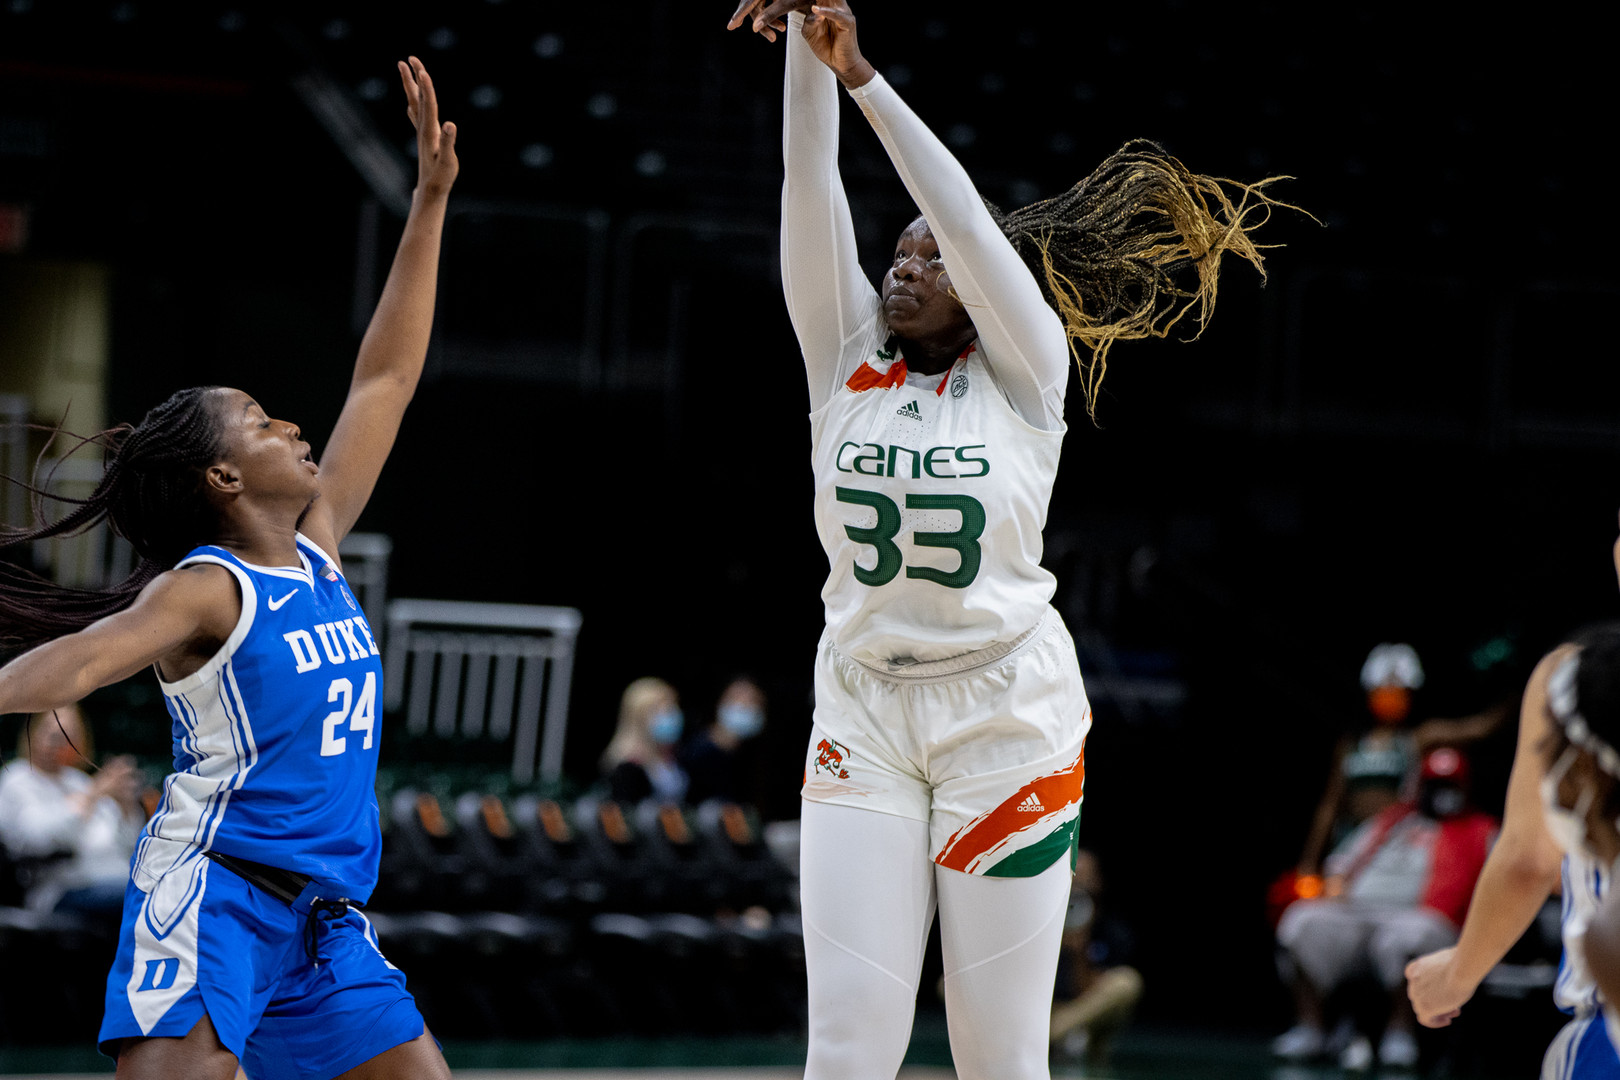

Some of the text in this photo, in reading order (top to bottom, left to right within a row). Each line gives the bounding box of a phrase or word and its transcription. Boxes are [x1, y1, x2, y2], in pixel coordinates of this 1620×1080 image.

[896, 409, 922, 421] adidas
[835, 486, 986, 589] 33
[283, 616, 380, 674] DUKE
[320, 672, 376, 757] 24
[136, 957, 180, 992] D
